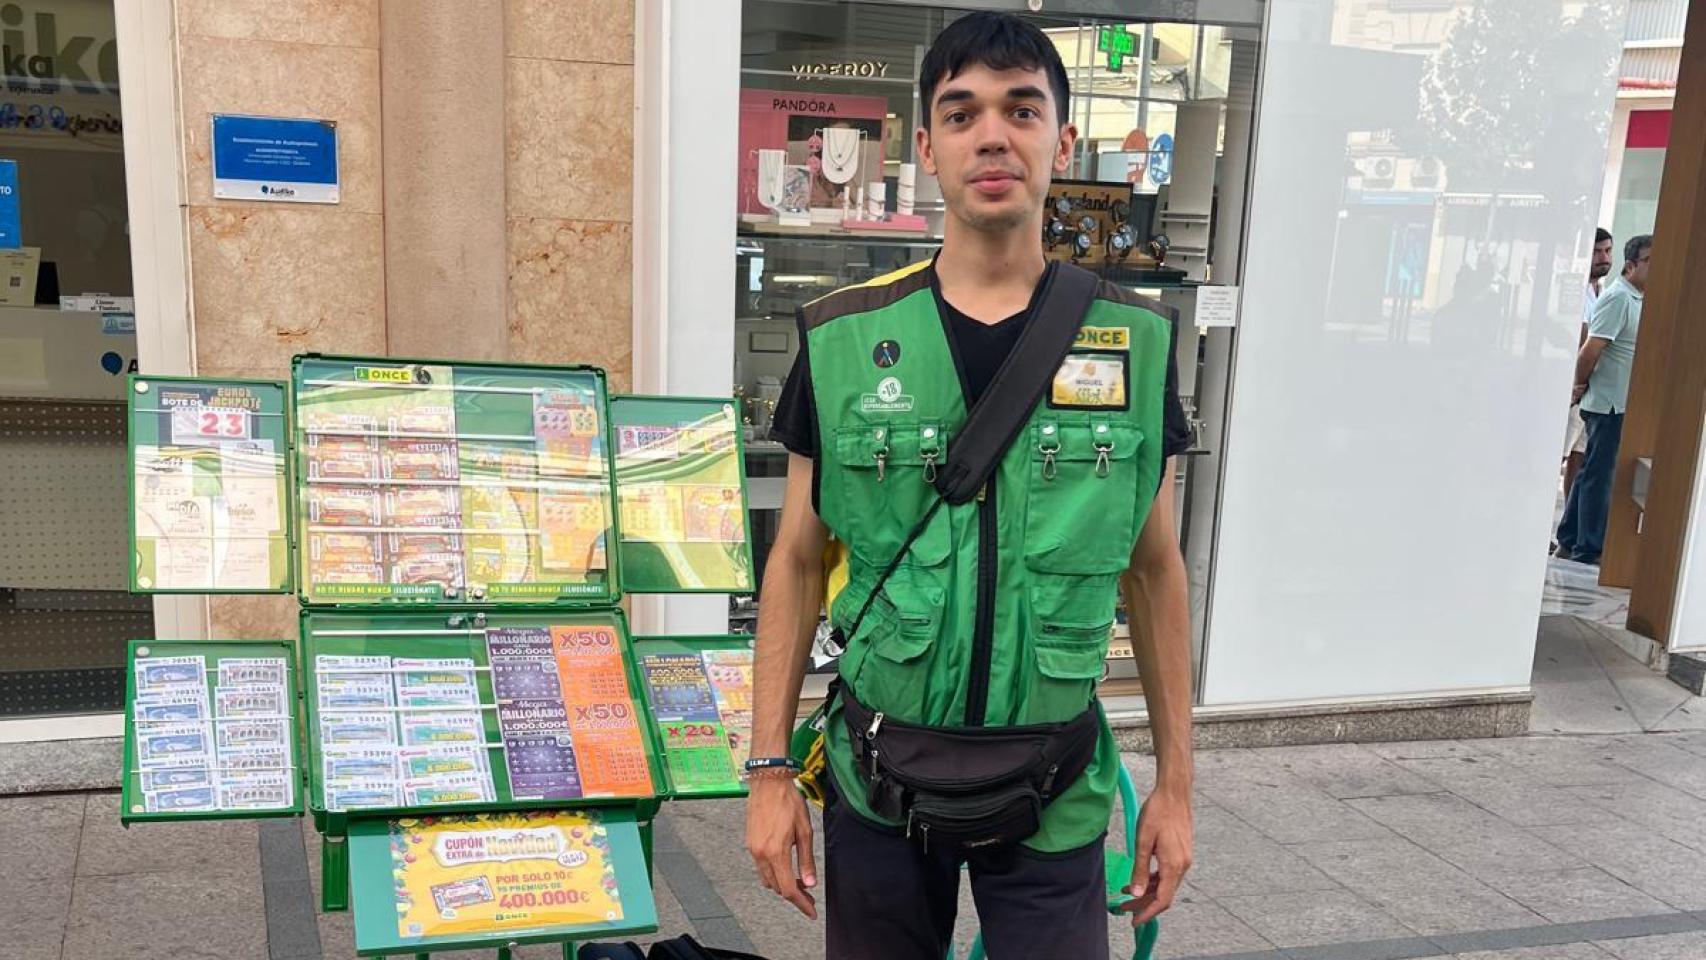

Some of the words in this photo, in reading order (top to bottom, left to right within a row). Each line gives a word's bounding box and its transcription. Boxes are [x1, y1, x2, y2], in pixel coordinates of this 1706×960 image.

[791, 61, 888, 80] VICEROY
[772, 98, 837, 113] PANDORA
[1073, 331, 1123, 345] ONCE
[371, 369, 409, 380] ONCE
[161, 397, 189, 406] BOTE
[200, 412, 243, 435] 23
[489, 634, 551, 644] MILLONARIO
[501, 708, 565, 720] MILLONARIO
[445, 835, 483, 850] CUPÓN
[485, 831, 558, 857] Navidad
[446, 850, 473, 860] EXTRA
[496, 874, 519, 885] POR
[521, 872, 550, 883] SOLO
[552, 871, 574, 881] 10€
[509, 882, 551, 892] PREMIOS
[499, 890, 590, 909] 400.000€
